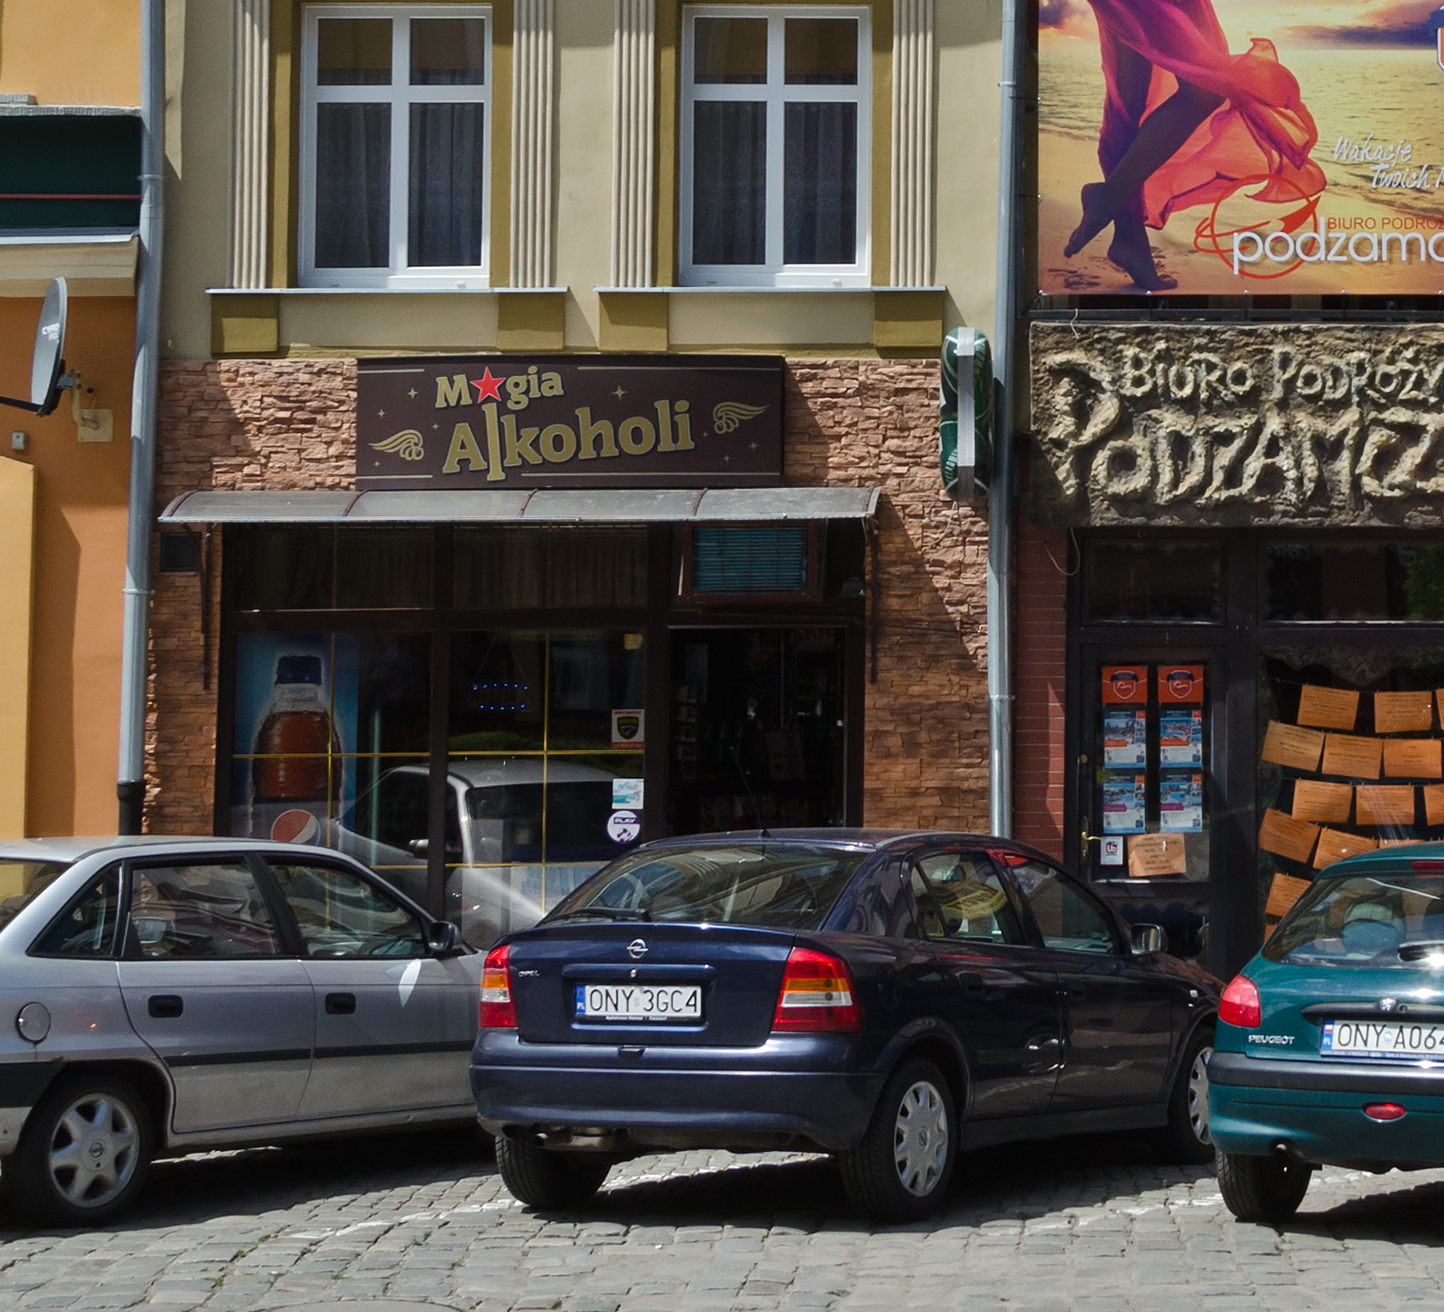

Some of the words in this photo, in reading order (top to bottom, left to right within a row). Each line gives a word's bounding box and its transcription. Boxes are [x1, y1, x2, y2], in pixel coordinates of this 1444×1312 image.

[1334, 133, 1412, 168] Wakacje
[1369, 162, 1430, 190] Twoich
[1327, 217, 1376, 230] BIURO
[1120, 339, 1256, 402] BIURO
[441, 399, 695, 482] Alkoholi
[518, 969, 540, 977] OPEL
[589, 988, 635, 1013] ONY
[643, 989, 698, 1013] 3GC4
[1248, 1034, 1295, 1045] PEUGEOT
[1337, 1022, 1387, 1048] ONY
